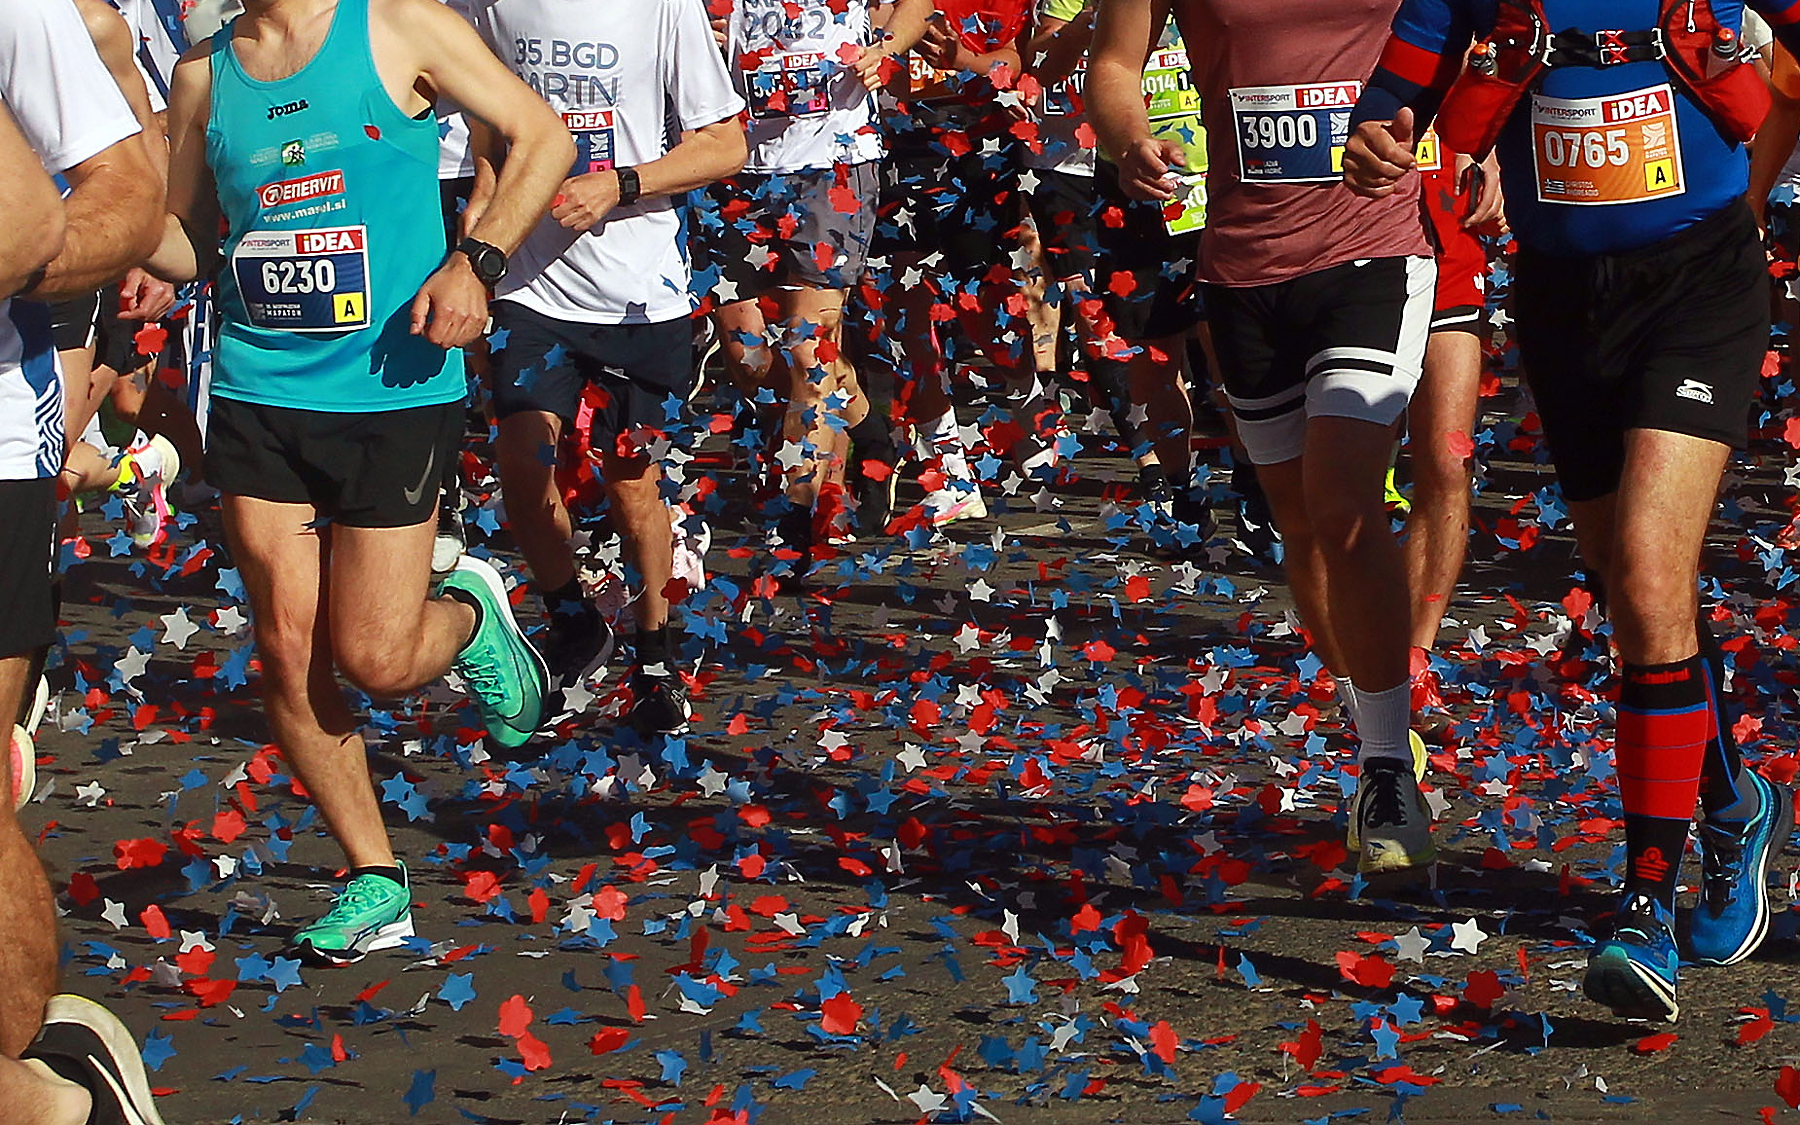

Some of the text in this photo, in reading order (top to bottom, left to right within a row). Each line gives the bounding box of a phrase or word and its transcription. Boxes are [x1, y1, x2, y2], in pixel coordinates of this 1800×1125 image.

[515, 39, 619, 70] 35.BGD
[1164, 53, 1187, 67] iDE
[909, 59, 935, 80] 34
[1244, 94, 1291, 103] INTERSPORT
[1303, 87, 1350, 106] iDEA
[1544, 107, 1597, 118] INTERSPORT
[1611, 94, 1663, 121] iDEA
[568, 112, 607, 128] iDEA
[1242, 114, 1318, 148] 3900
[1421, 146, 1429, 160] A
[1544, 129, 1630, 168] 0765
[1655, 166, 1667, 185] A
[245, 239, 291, 248] INTERSPORT
[303, 231, 356, 253] iDEA
[262, 259, 336, 294] 6230
[344, 300, 356, 317] A
